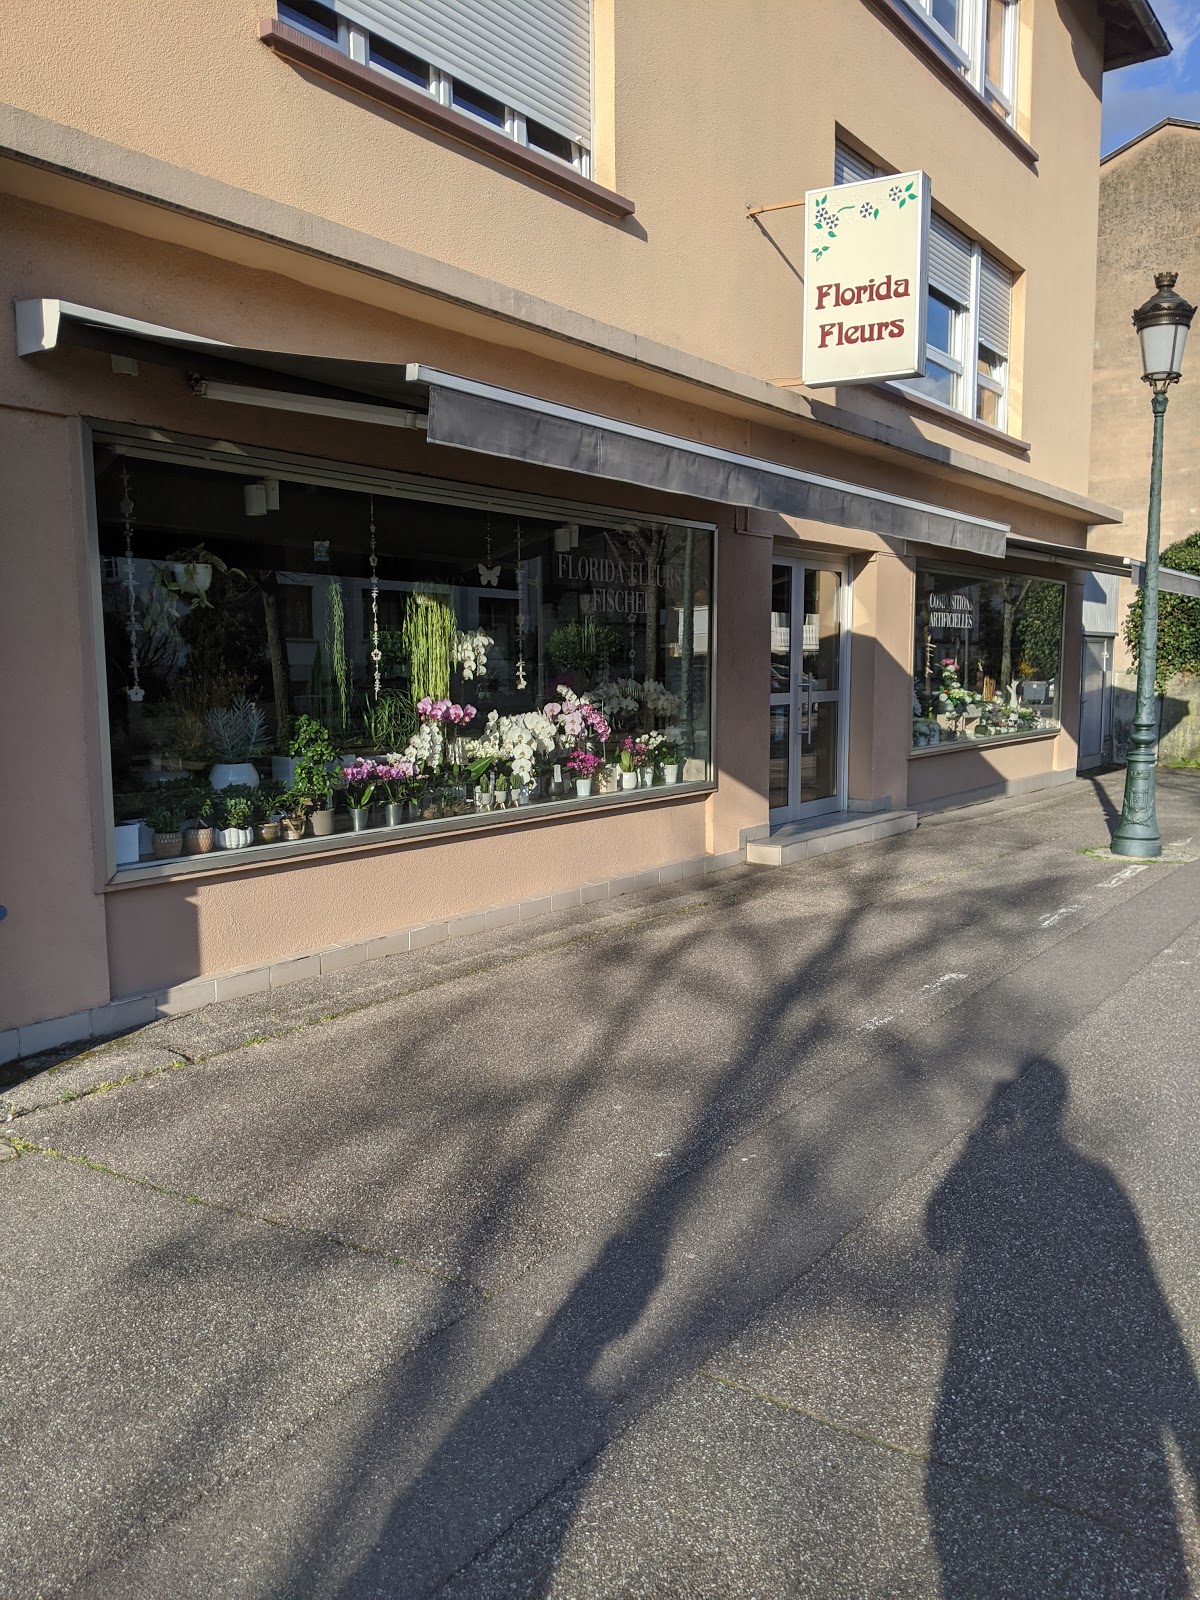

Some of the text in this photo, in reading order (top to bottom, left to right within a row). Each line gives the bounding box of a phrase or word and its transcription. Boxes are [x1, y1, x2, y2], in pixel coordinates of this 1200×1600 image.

[815, 274, 911, 310] Florida
[817, 318, 905, 348] Fleurs
[558, 553, 683, 587] FLORIDA FLEURS
[928, 611, 973, 629] ARTIFICIELLES
